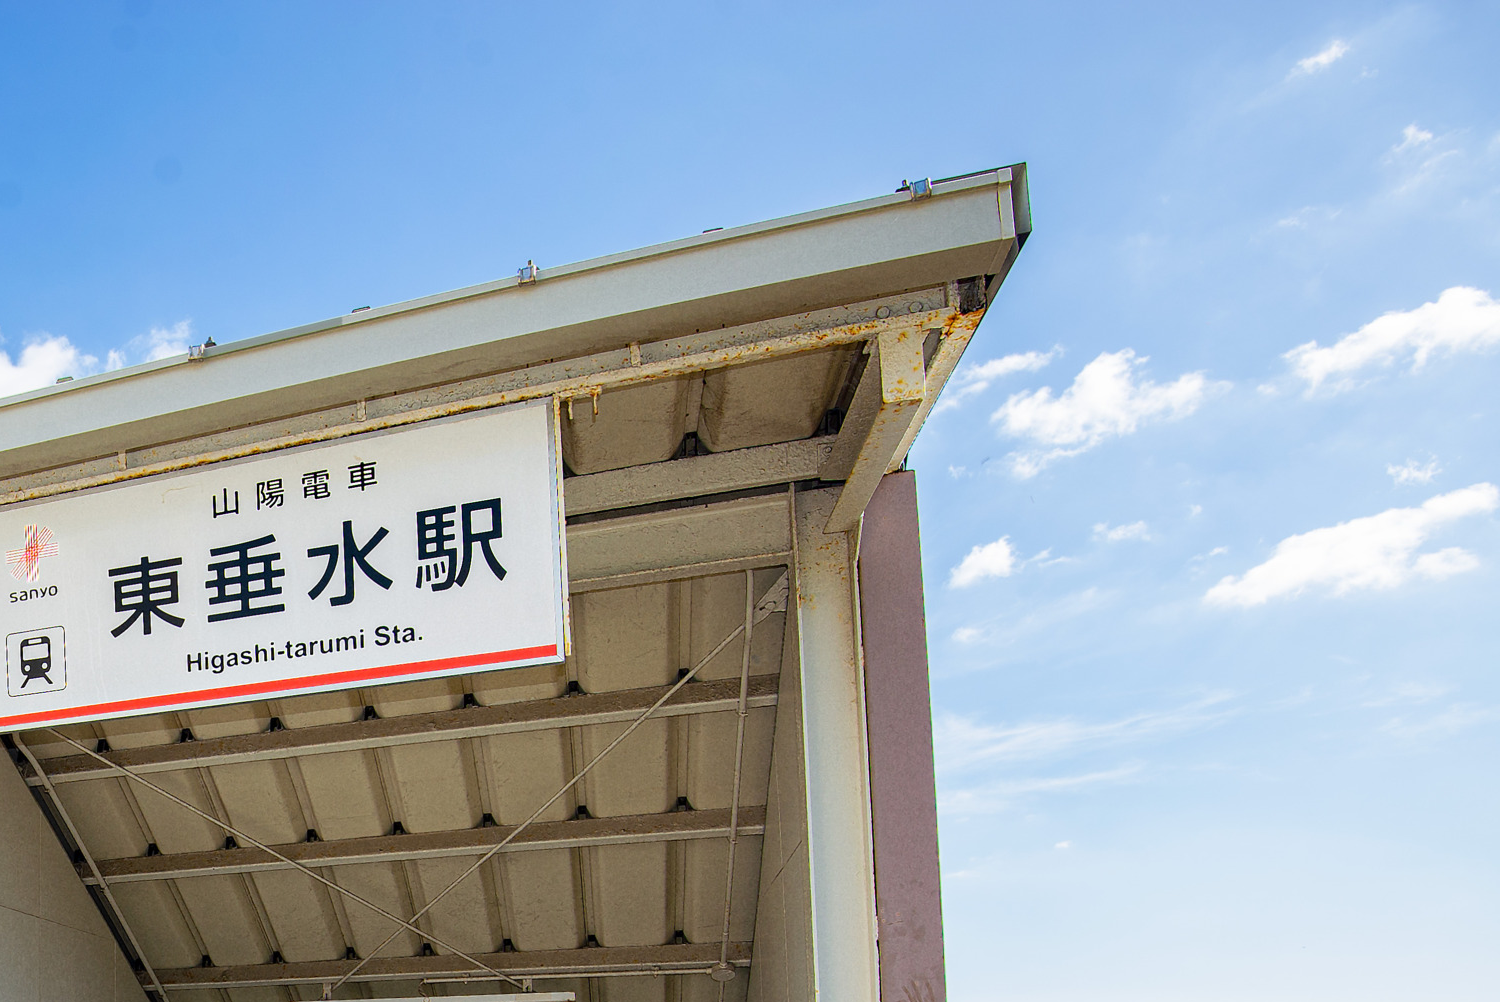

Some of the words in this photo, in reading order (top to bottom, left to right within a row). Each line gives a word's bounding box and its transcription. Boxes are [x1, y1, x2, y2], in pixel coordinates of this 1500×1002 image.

[211, 461, 379, 519] 山陽電車
[9, 583, 59, 604] sanyo
[107, 497, 508, 639] 東垂水駅
[186, 627, 366, 674] Higashi-tarumi
[375, 624, 425, 648] Sta.
